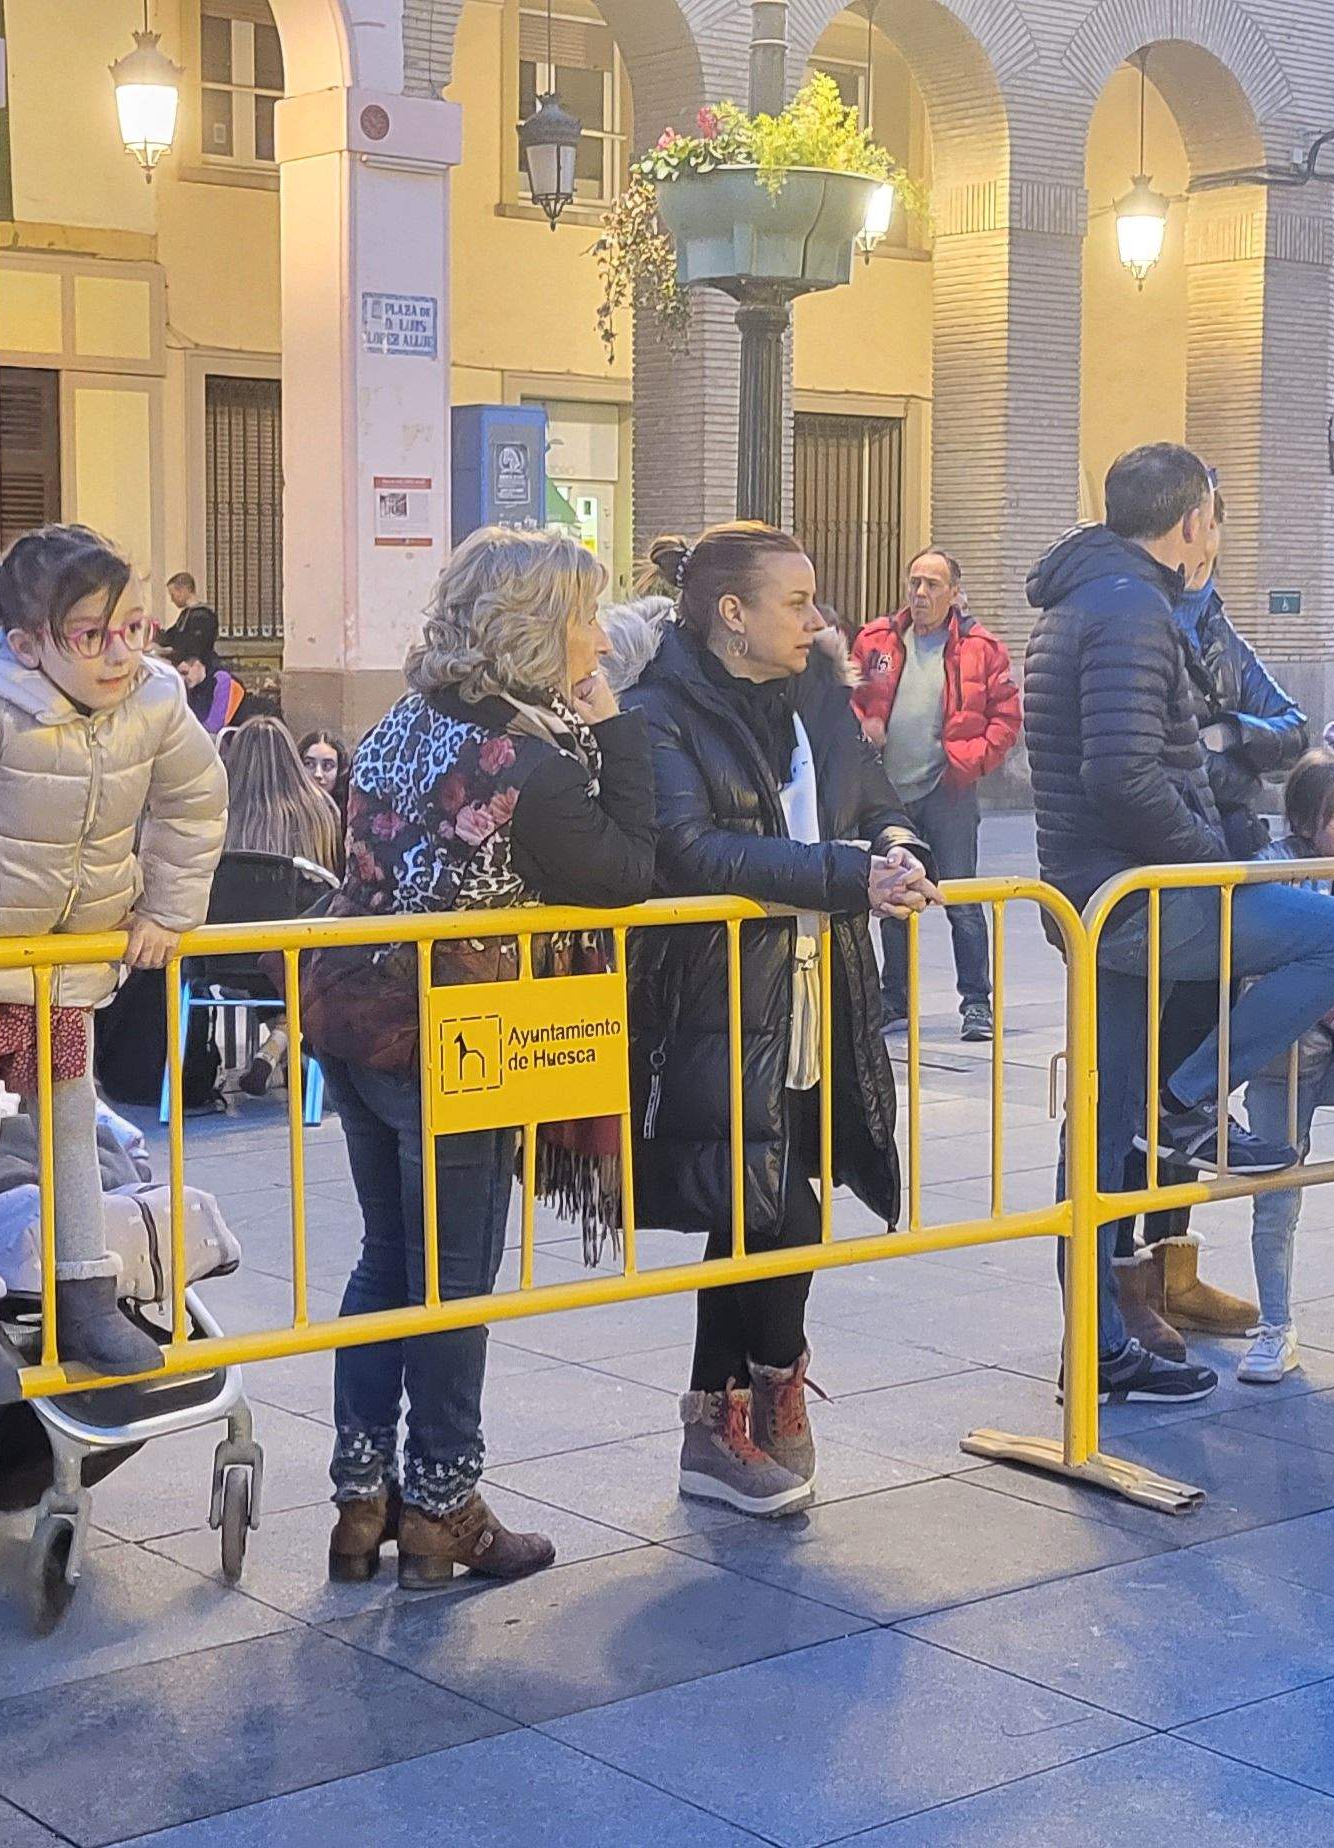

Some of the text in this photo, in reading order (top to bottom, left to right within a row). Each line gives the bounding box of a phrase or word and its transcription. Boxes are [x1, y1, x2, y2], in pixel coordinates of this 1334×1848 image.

[385, 303, 417, 316] PLAZA
[399, 319, 427, 333] LUIS
[507, 1018, 621, 1049] Ayuntamiento
[508, 1048, 596, 1071] de Huesca
